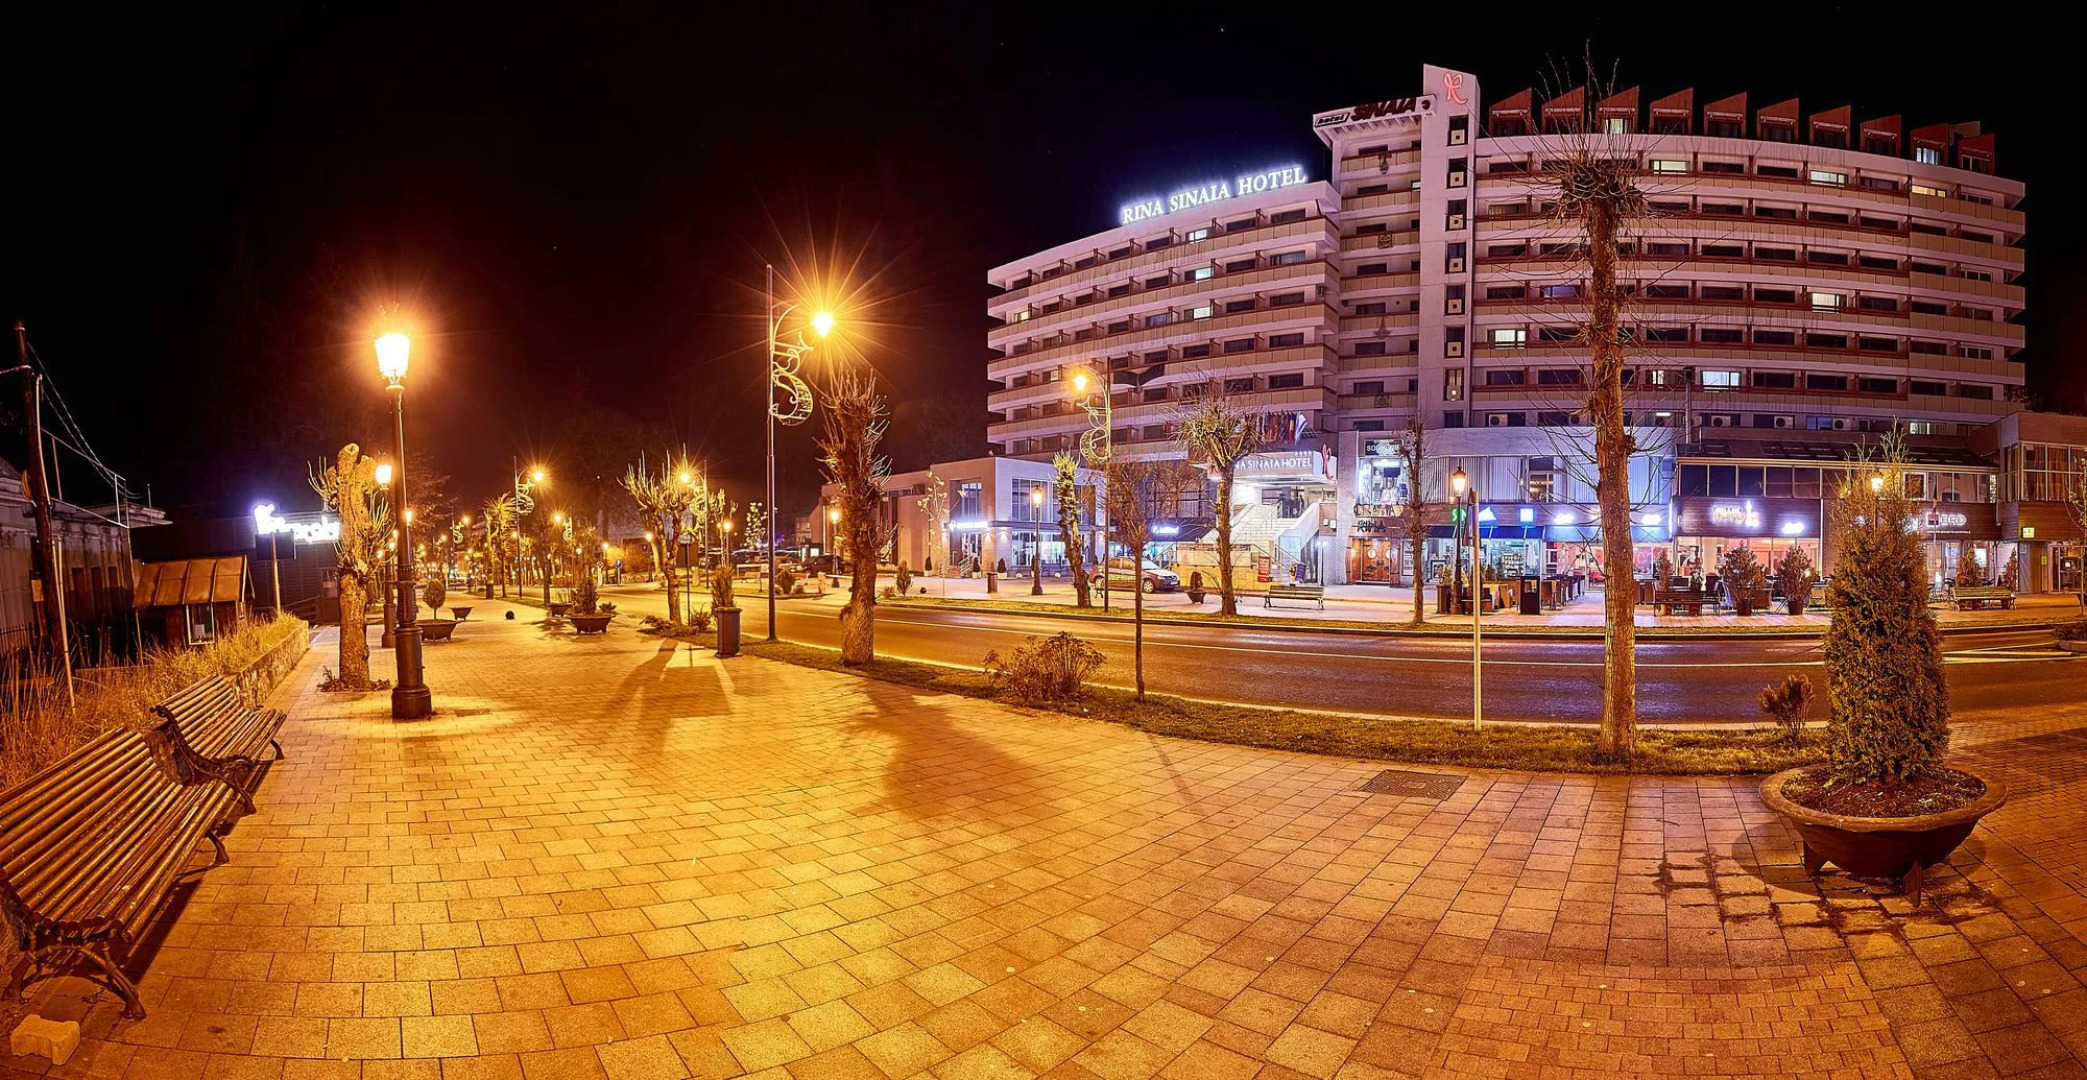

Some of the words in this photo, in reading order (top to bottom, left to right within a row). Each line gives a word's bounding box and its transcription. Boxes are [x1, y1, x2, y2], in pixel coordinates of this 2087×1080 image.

[1350, 97, 1417, 122] SINAIA
[1123, 202, 1164, 224] RINA
[1170, 183, 1231, 212] SINAIA
[1238, 167, 1306, 195] HOTEL
[1247, 458, 1281, 469] SINAIA
[1281, 457, 1313, 468] HOTEL
